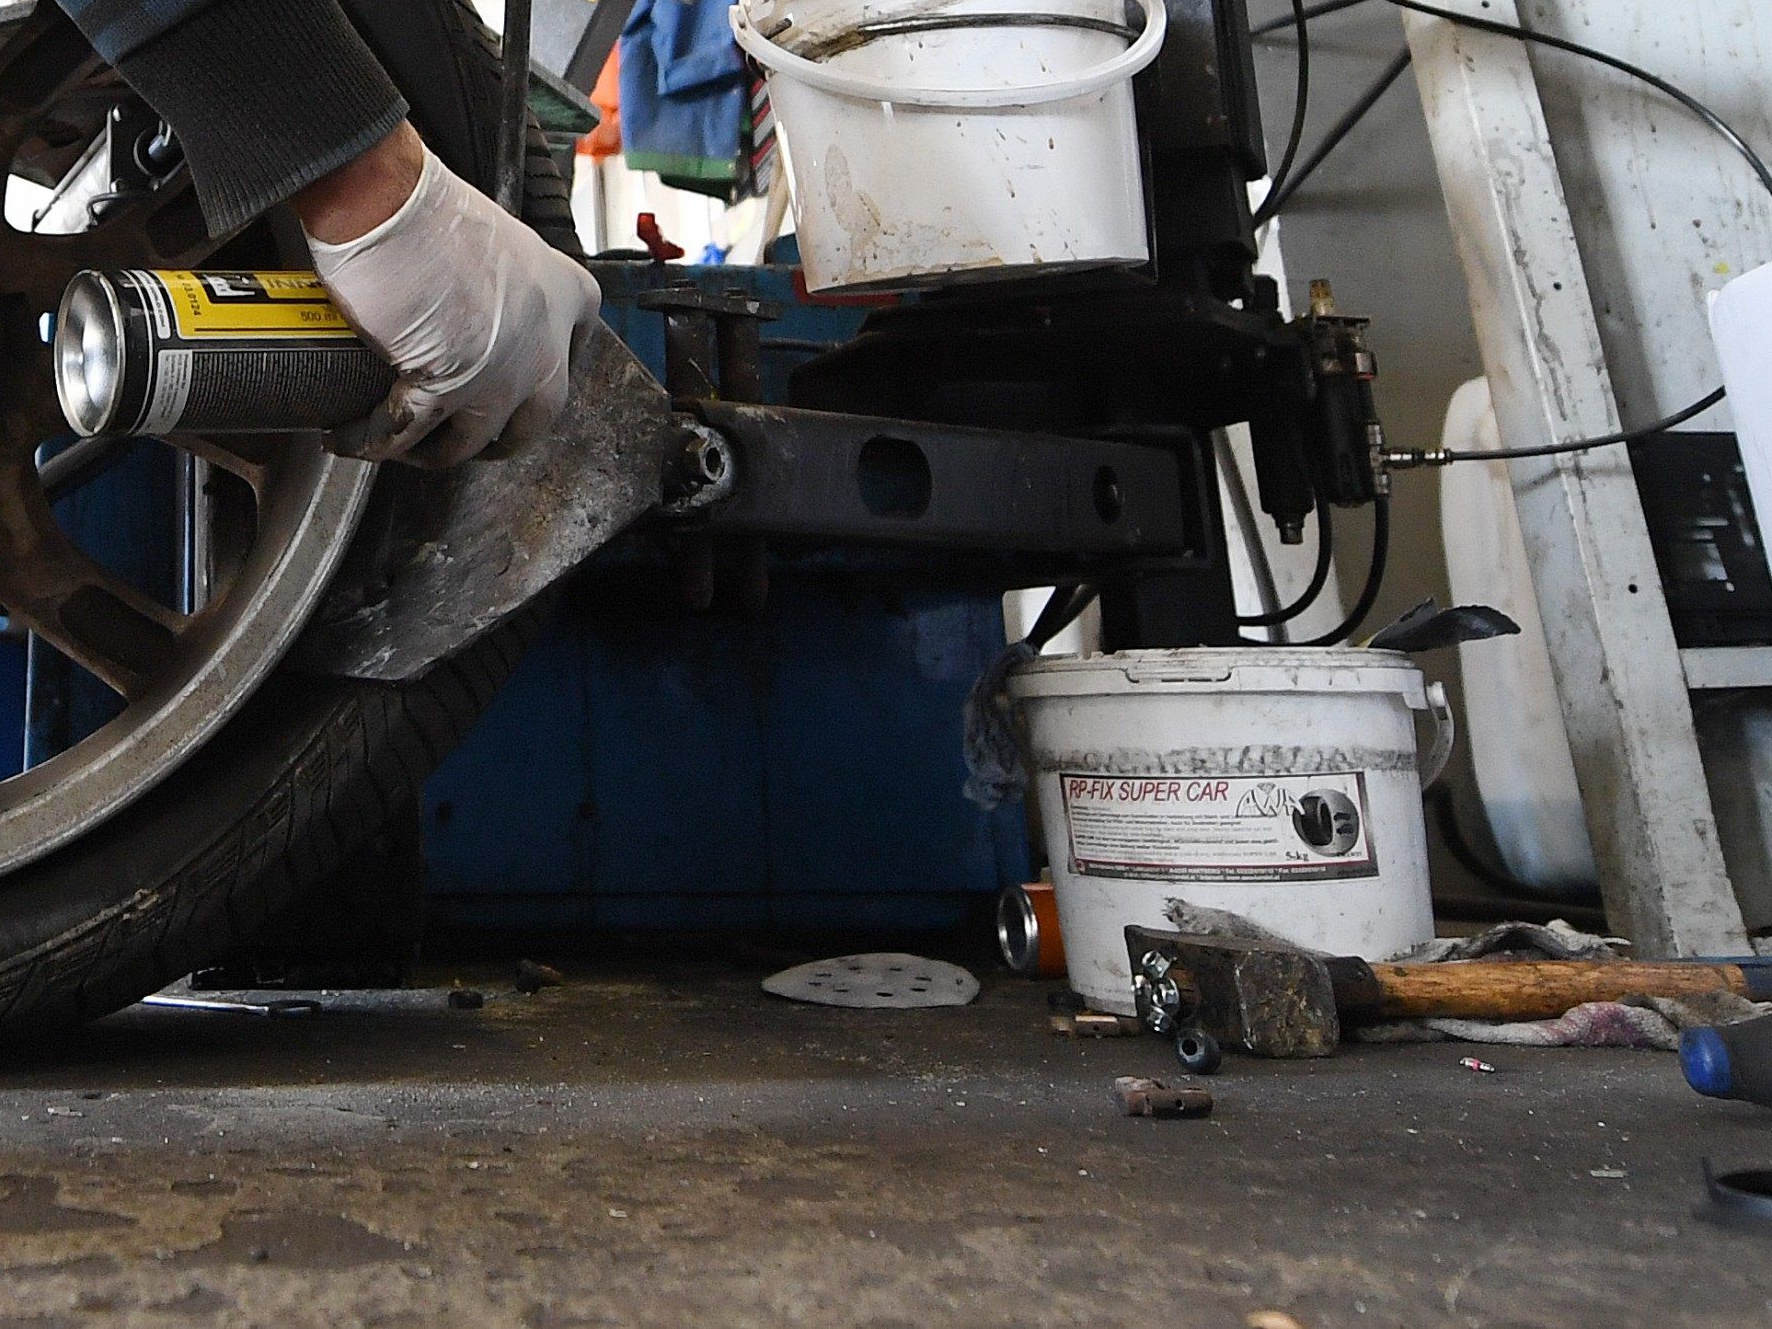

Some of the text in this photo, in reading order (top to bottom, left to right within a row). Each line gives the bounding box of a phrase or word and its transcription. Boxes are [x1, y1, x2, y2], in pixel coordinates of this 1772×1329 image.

[301, 310, 321, 321] 500
[1069, 779, 1229, 802] RP-FIX SUPER CAR
